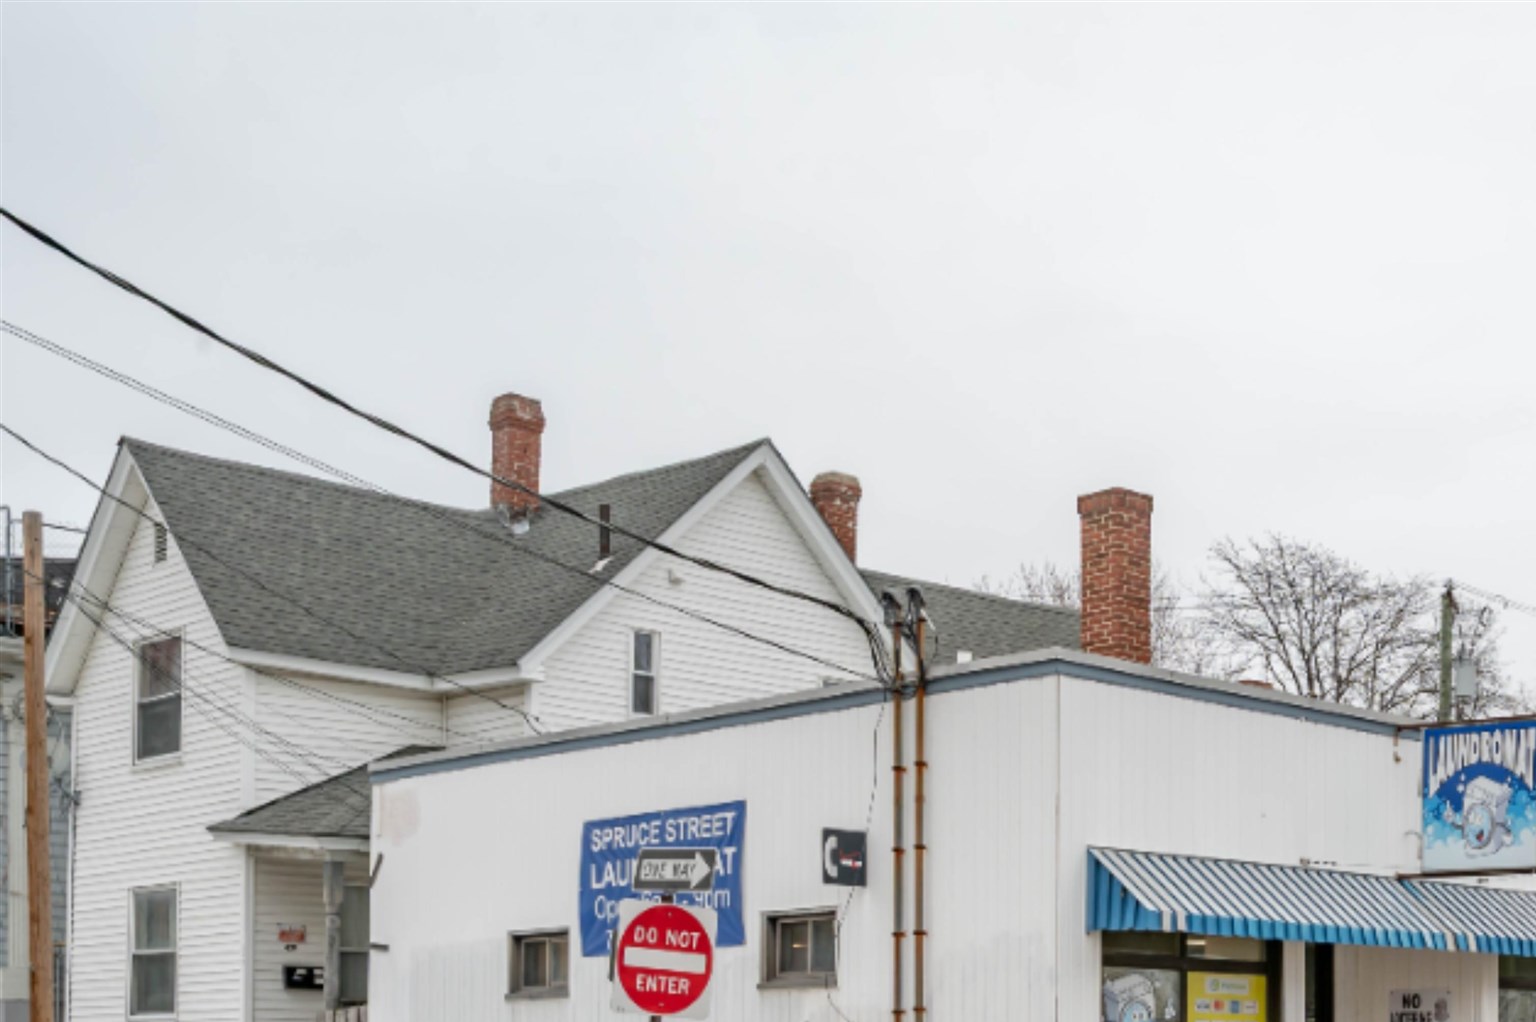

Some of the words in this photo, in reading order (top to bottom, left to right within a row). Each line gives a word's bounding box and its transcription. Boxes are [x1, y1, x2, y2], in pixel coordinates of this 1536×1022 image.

[1428, 727, 1536, 798] LAUNDROMAT
[591, 819, 661, 852] SPRUCE
[664, 811, 736, 843] STREET
[590, 846, 737, 890] LAUAT
[642, 861, 667, 879] ONE
[672, 862, 696, 880] WAY
[633, 924, 658, 943] DO
[665, 928, 701, 951] NOT
[635, 973, 691, 995] ENTER
[1402, 993, 1421, 1009] NO
